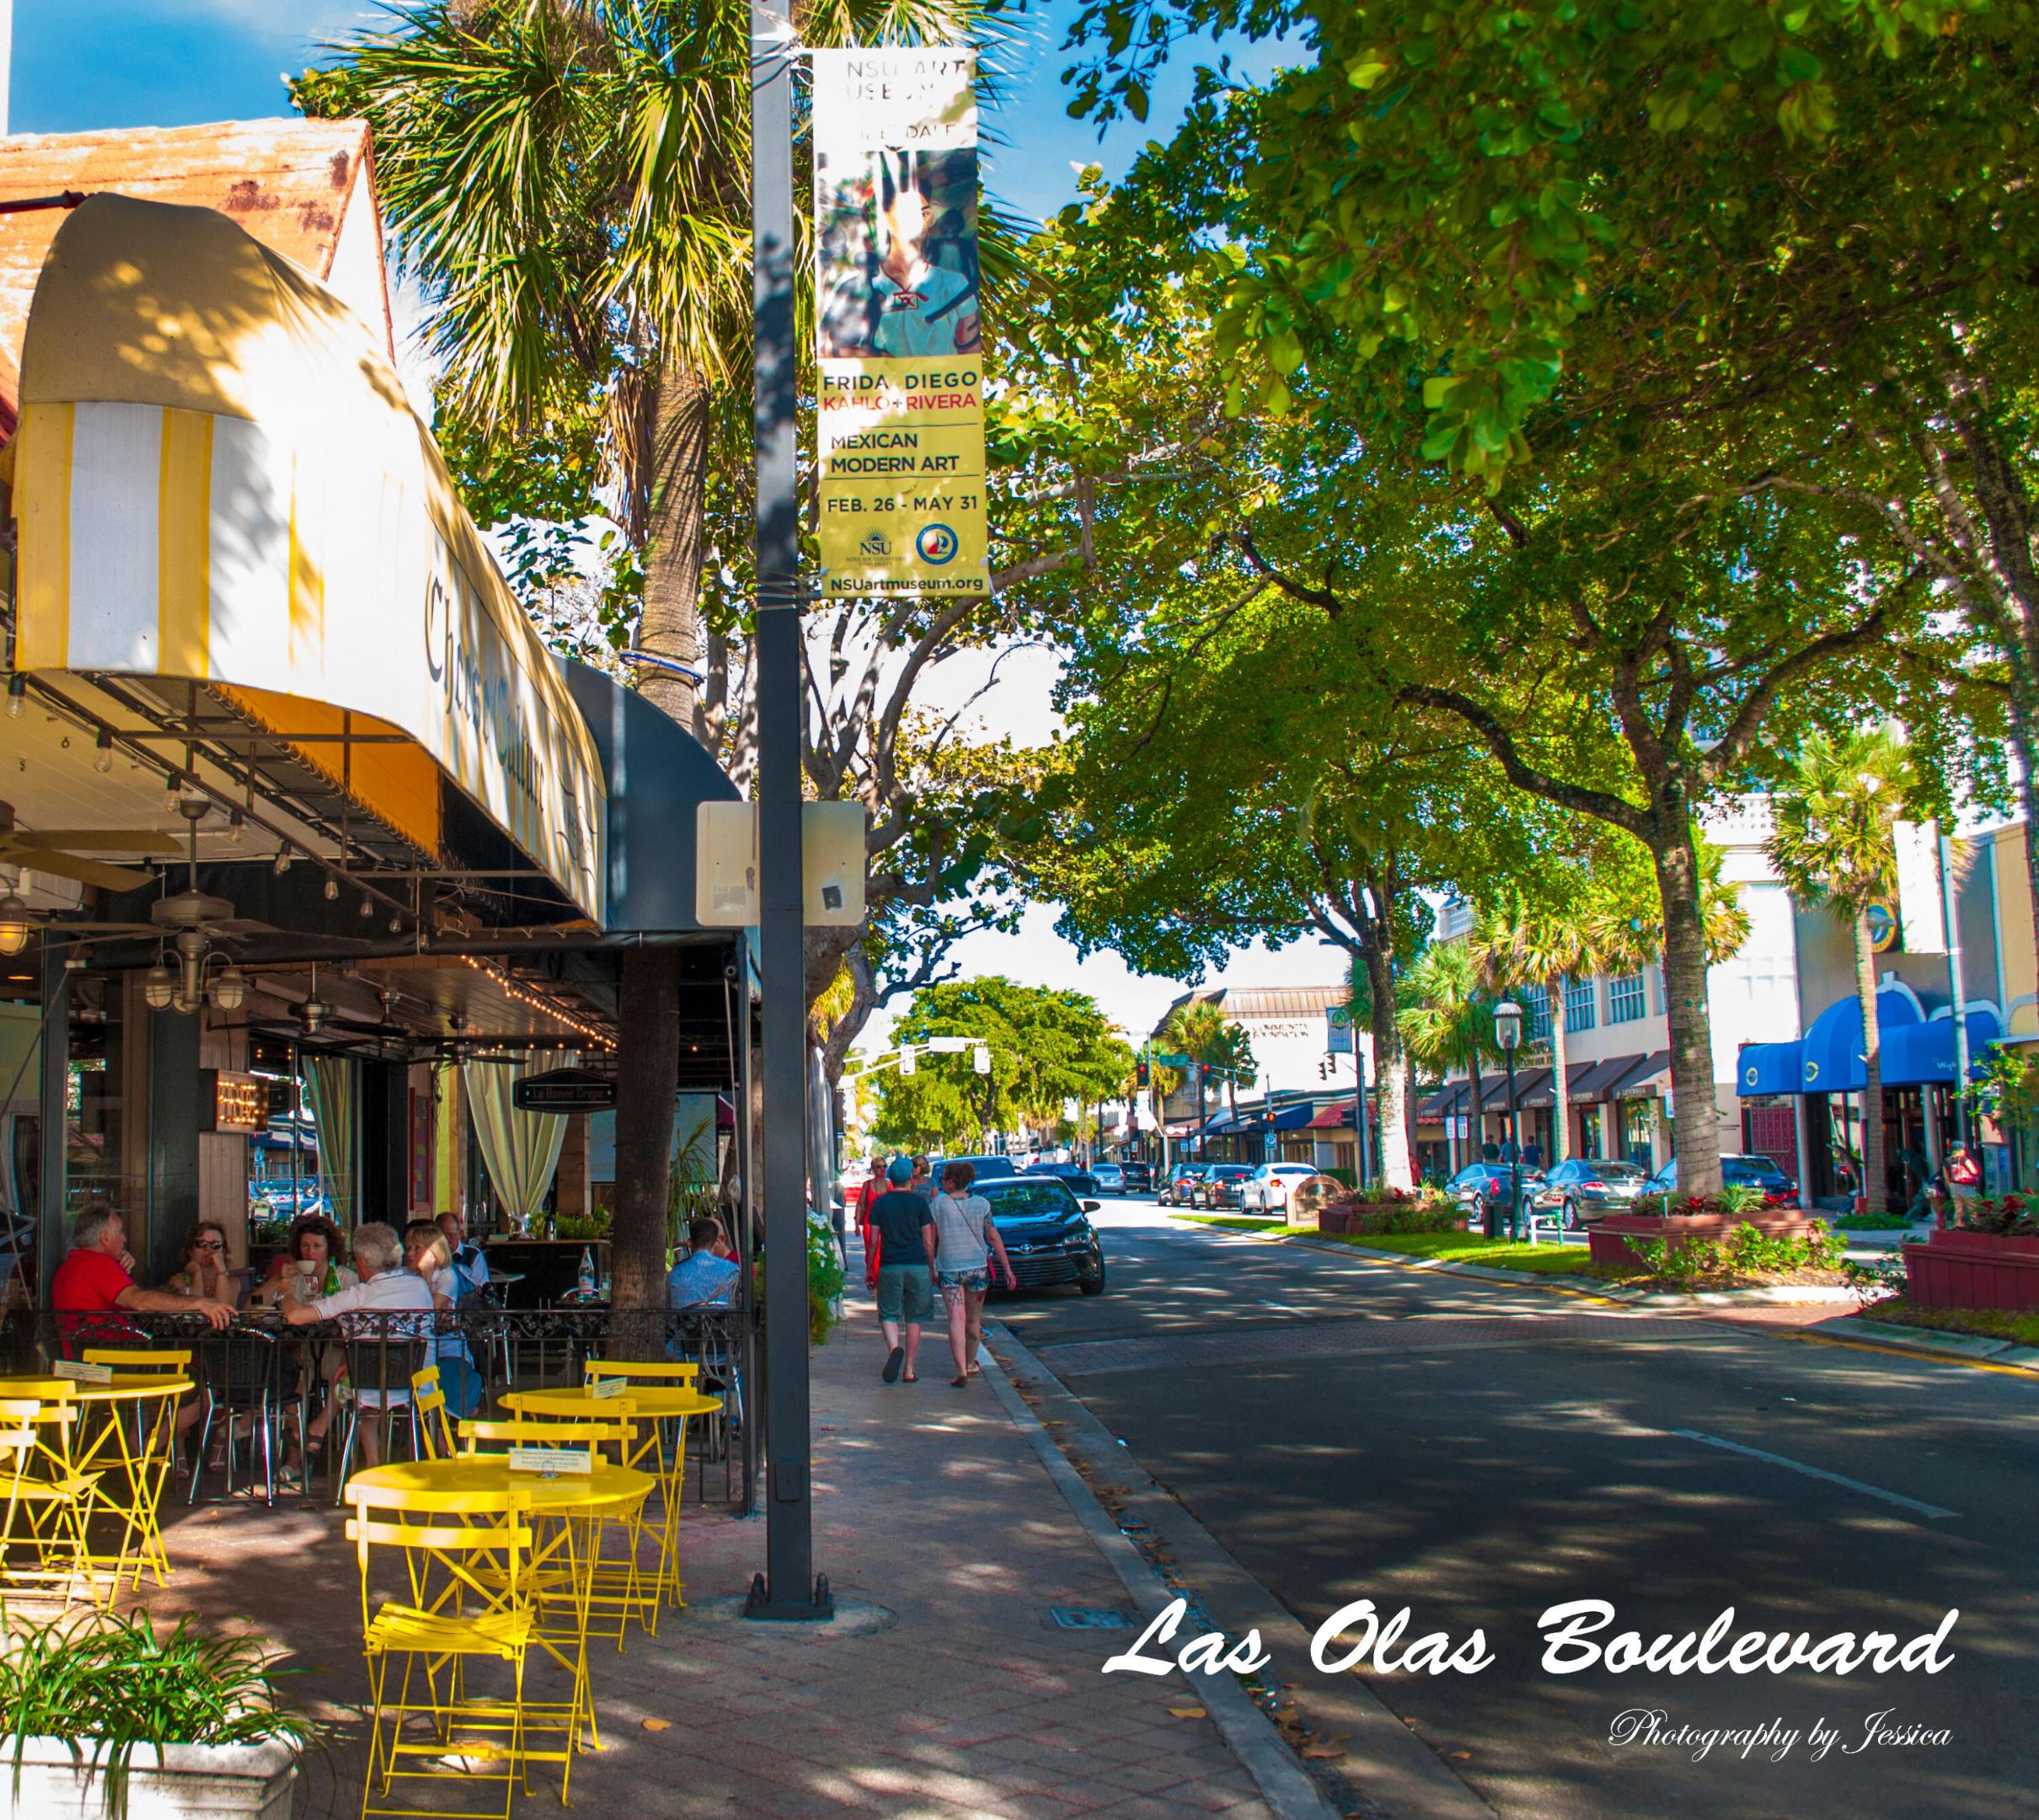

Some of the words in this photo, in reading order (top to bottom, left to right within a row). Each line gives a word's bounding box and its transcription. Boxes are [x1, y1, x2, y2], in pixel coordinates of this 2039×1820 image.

[823, 374, 889, 391] FRIDA
[905, 371, 978, 389] DIEGO
[823, 395, 891, 411] KAHLO
[906, 393, 977, 410] RIVERA
[831, 433, 918, 450] MEXICAN
[831, 456, 915, 473] MODERN
[920, 455, 961, 471] ART
[827, 498, 868, 512] FEB.
[873, 498, 896, 511] 26
[913, 496, 954, 511] MAY
[960, 495, 977, 510] 31
[859, 541, 892, 555] NSU
[831, 578, 983, 591] NSUartmuseum.org
